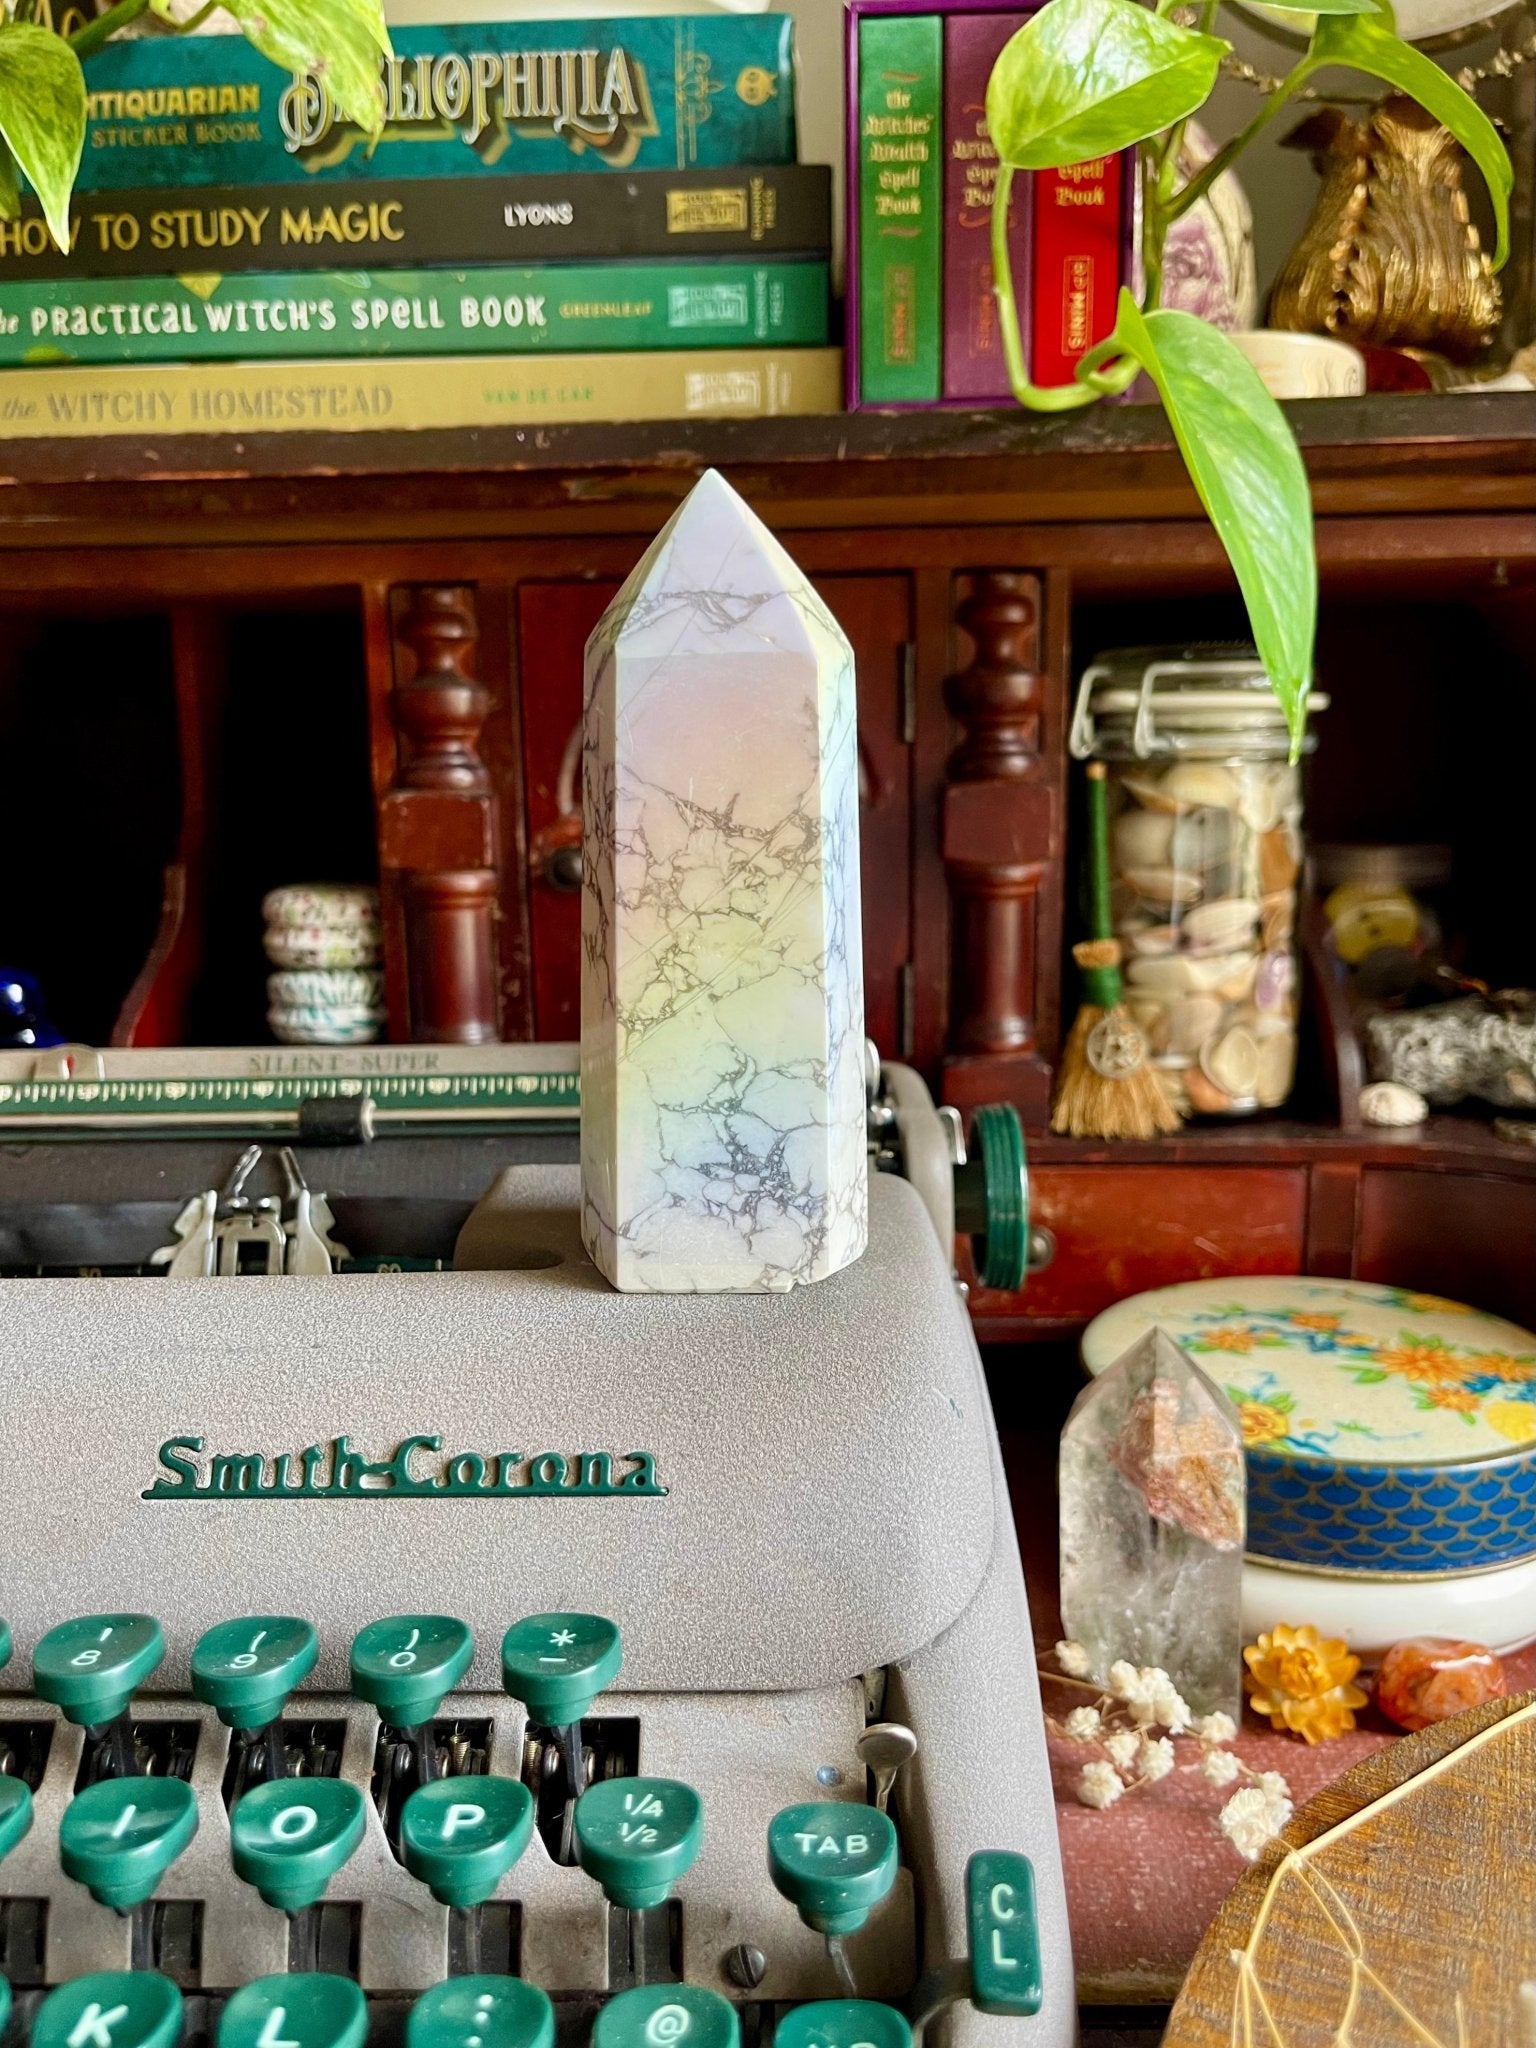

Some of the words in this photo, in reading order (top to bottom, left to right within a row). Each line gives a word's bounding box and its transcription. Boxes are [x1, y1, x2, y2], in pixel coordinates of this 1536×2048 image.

[278, 46, 640, 153] BLIOPHILIA
[91, 123, 188, 149] STICKER
[195, 121, 261, 144] BOOK
[879, 165, 920, 193] Spell
[1057, 161, 1105, 183] Spell
[875, 194, 921, 215] Book
[1056, 186, 1105, 206] Book
[91, 212, 140, 251] TO
[150, 207, 270, 249] STUDY
[281, 202, 404, 244] MAGIC
[503, 202, 574, 226] LYONS
[459, 294, 547, 328] BOOK
[4, 395, 37, 420] the
[47, 391, 177, 422] WITCHY
[190, 384, 393, 419] HOMESTEAD
[141, 1435, 668, 1500] Smith-Corona
[70, 1650, 102, 1667] 8
[229, 1653, 258, 1669] 9
[441, 1804, 486, 1840] P
[794, 1832, 869, 1855] TAB
[67, 2004, 128, 2048] K
[256, 2006, 300, 2048] L
[646, 2004, 689, 2043] @
